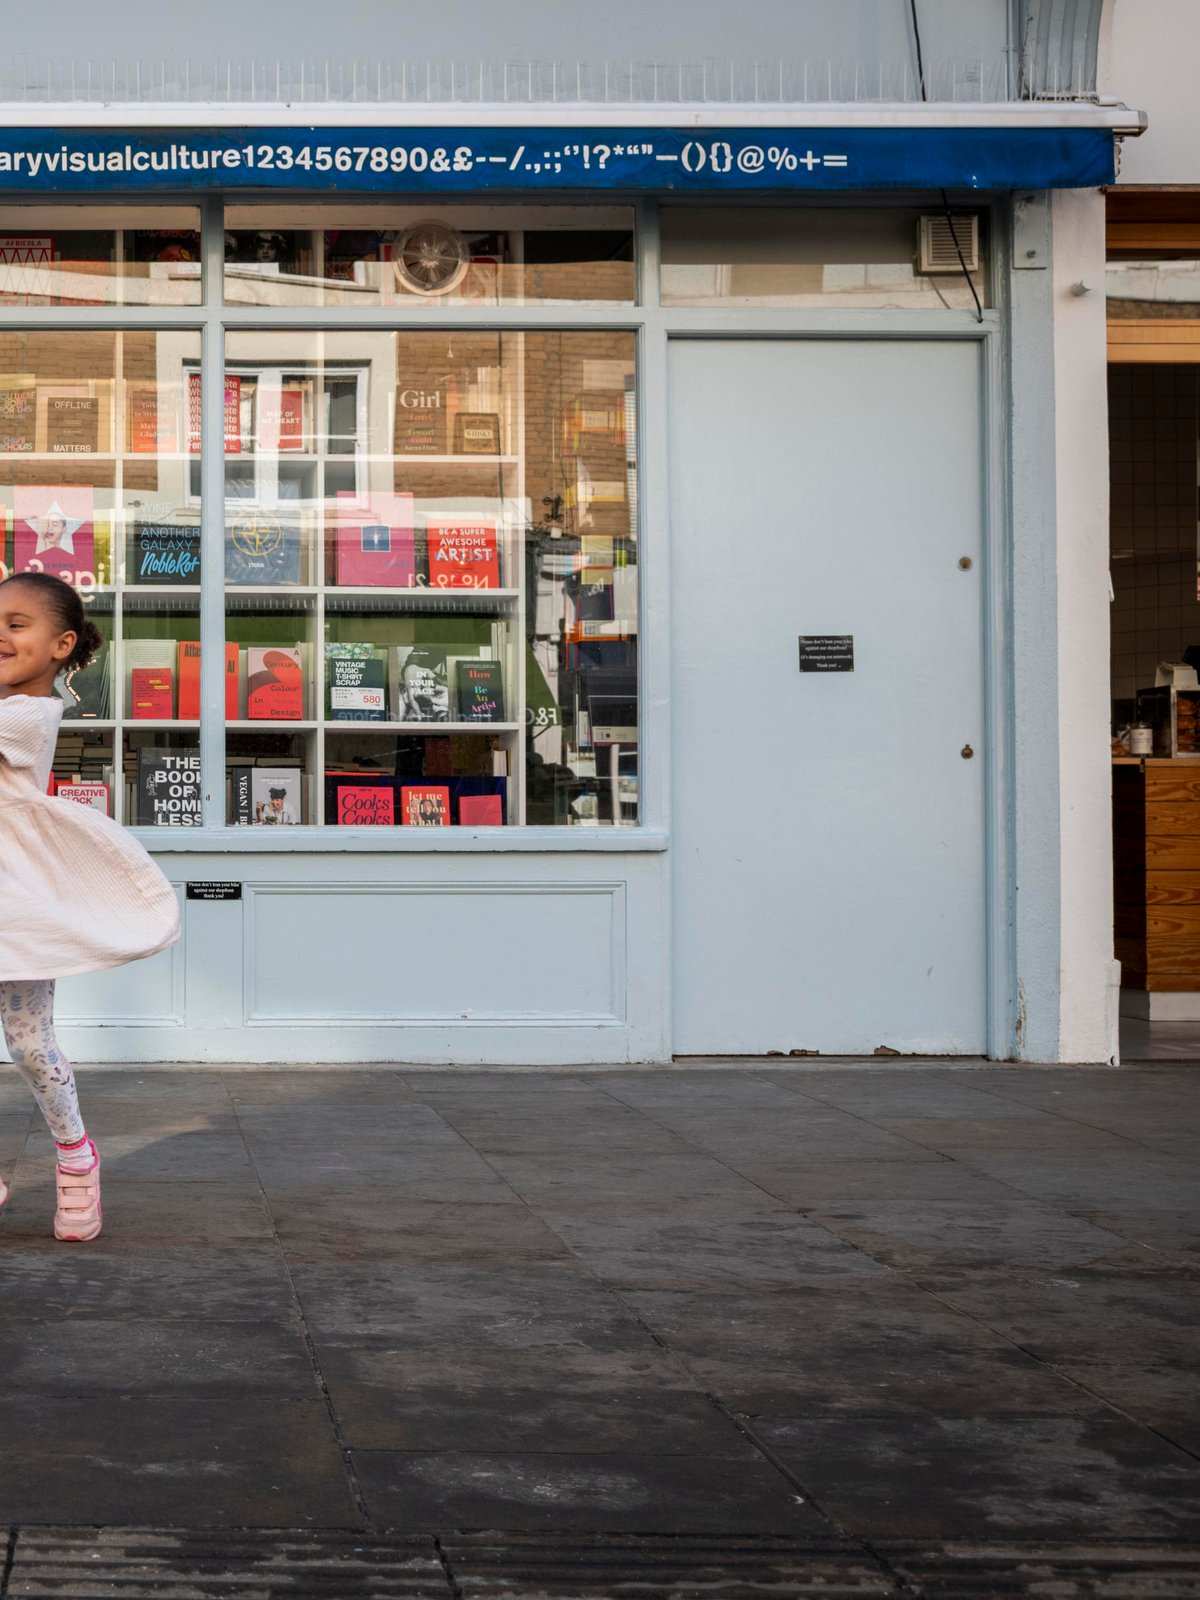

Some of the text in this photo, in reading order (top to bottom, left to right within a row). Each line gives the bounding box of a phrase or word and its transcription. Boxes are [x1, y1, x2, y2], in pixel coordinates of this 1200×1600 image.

[400, 390, 440, 409] Girl
[54, 401, 92, 409] OFFLINE
[54, 444, 91, 452] MATTERS
[141, 527, 201, 538] ANOTHER
[141, 540, 193, 550] GALAXY
[440, 538, 487, 546] AWESOME
[435, 548, 493, 561] ARTIST
[265, 661, 299, 670] Century
[335, 661, 366, 669] VINTAGE
[416, 670, 427, 678] IN
[469, 669, 491, 679] How
[409, 679, 435, 687] YOUR
[271, 684, 300, 692] Colour
[474, 686, 488, 694] Be
[363, 695, 381, 704] 580
[474, 694, 488, 702] An
[471, 701, 497, 713] Artist
[270, 708, 301, 717] Design
[162, 757, 201, 769] THE
[60, 789, 105, 798] CREATIVE
[169, 785, 195, 798] OF
[239, 775, 248, 807] VEGAN
[409, 791, 443, 801] let me
[341, 793, 390, 811] Cooks
[406, 803, 424, 814] tell
[157, 813, 202, 826] LESS
[341, 810, 390, 826] Cooks
[409, 817, 437, 826] what
